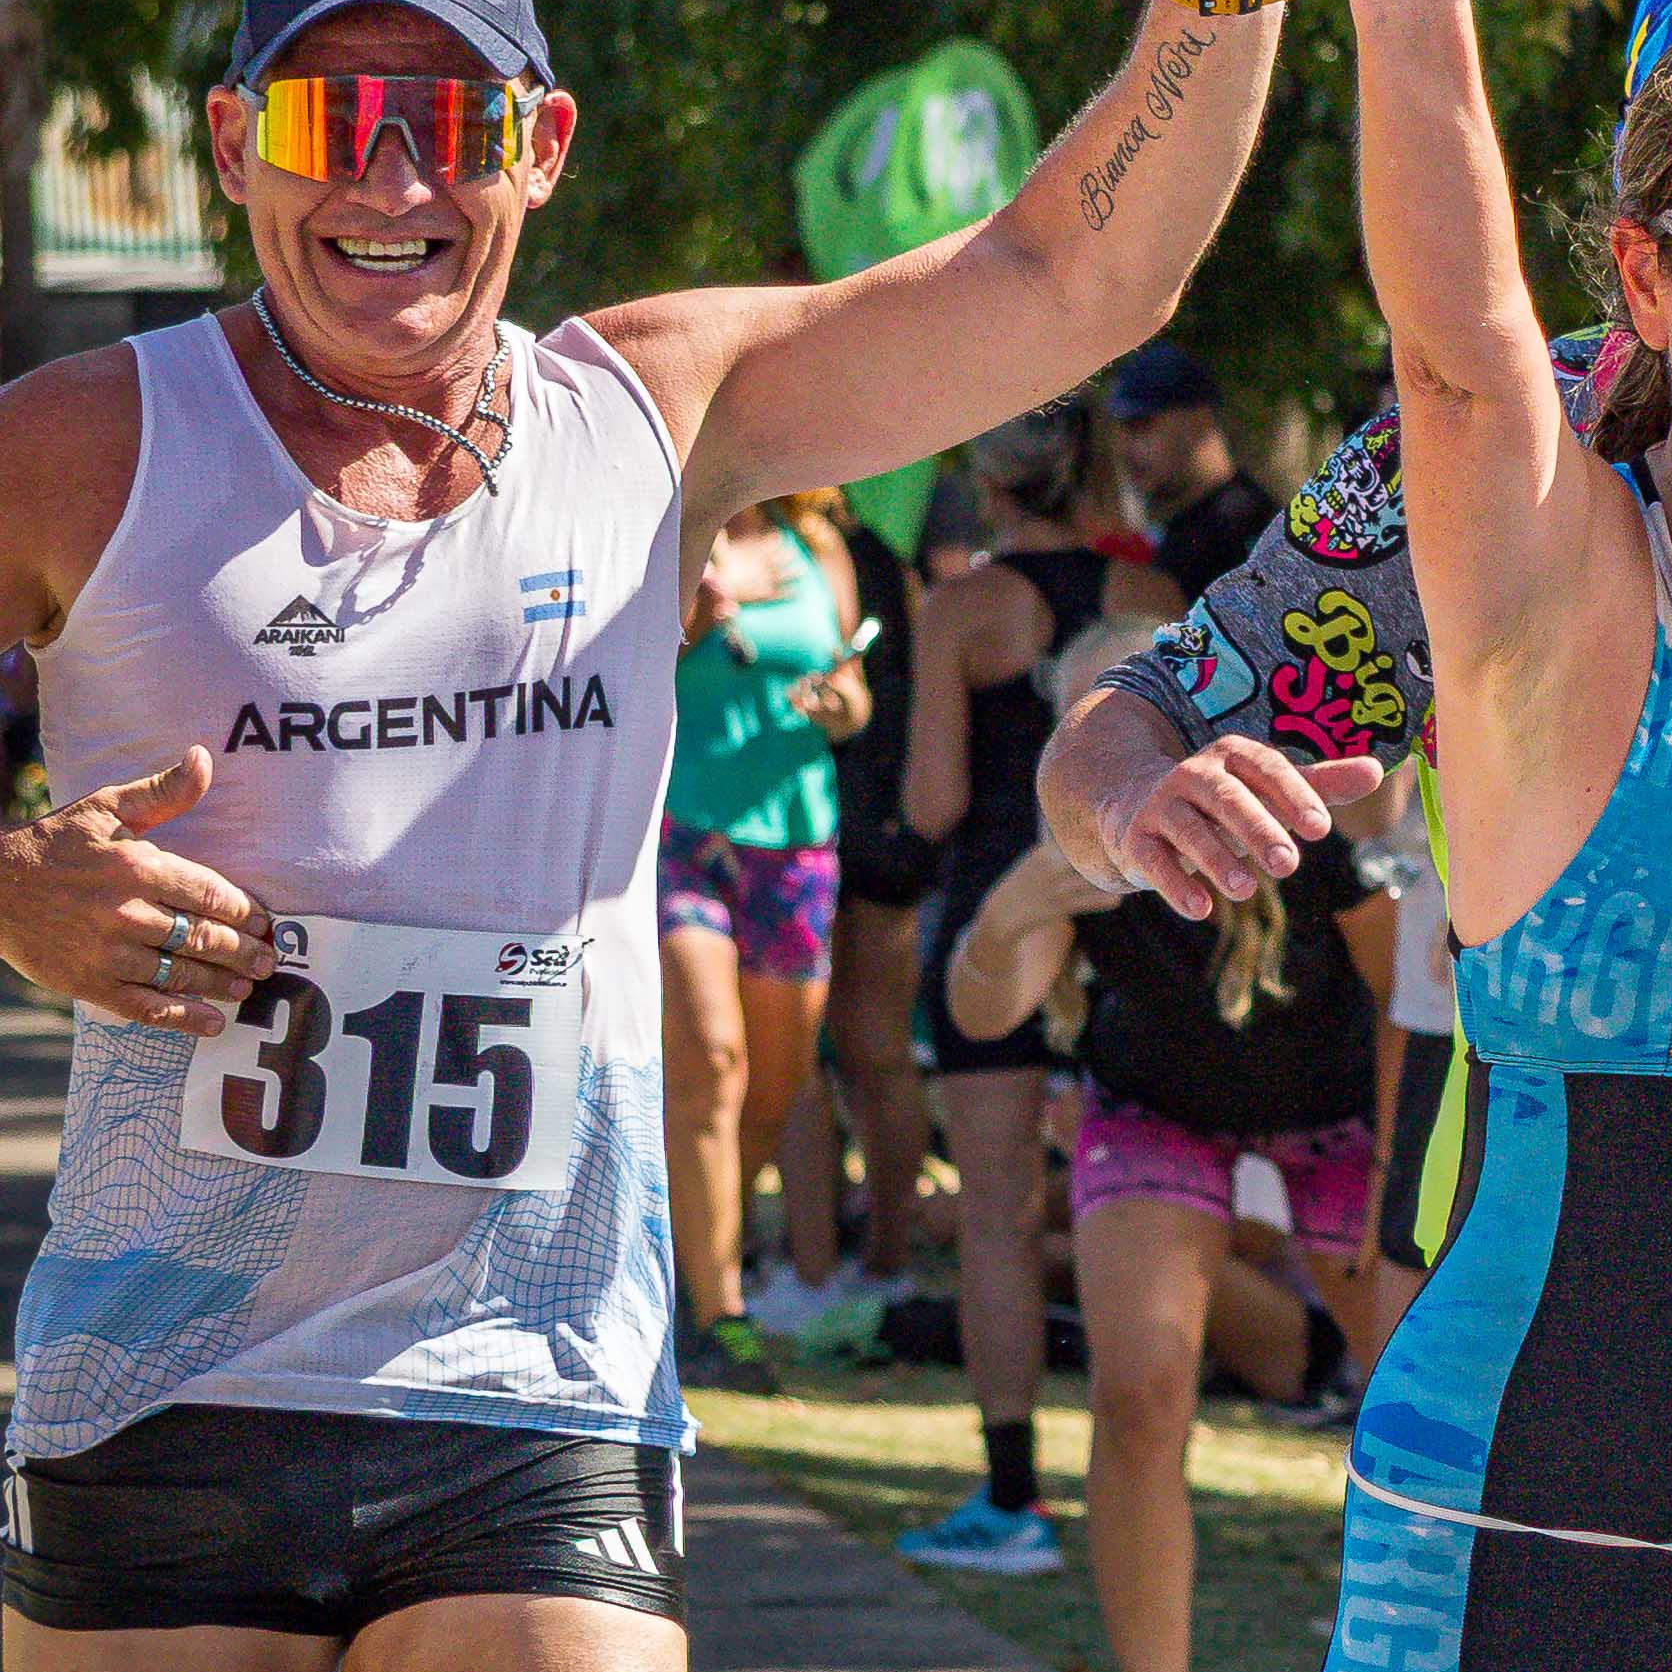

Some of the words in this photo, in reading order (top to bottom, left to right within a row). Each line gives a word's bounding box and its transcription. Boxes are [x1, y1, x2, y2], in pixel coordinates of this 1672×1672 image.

[1080, 114, 1161, 231] Bianca
[224, 674, 614, 753] ARGENTINA
[1284, 589, 1407, 729] Big
[220, 971, 534, 1179] 315
